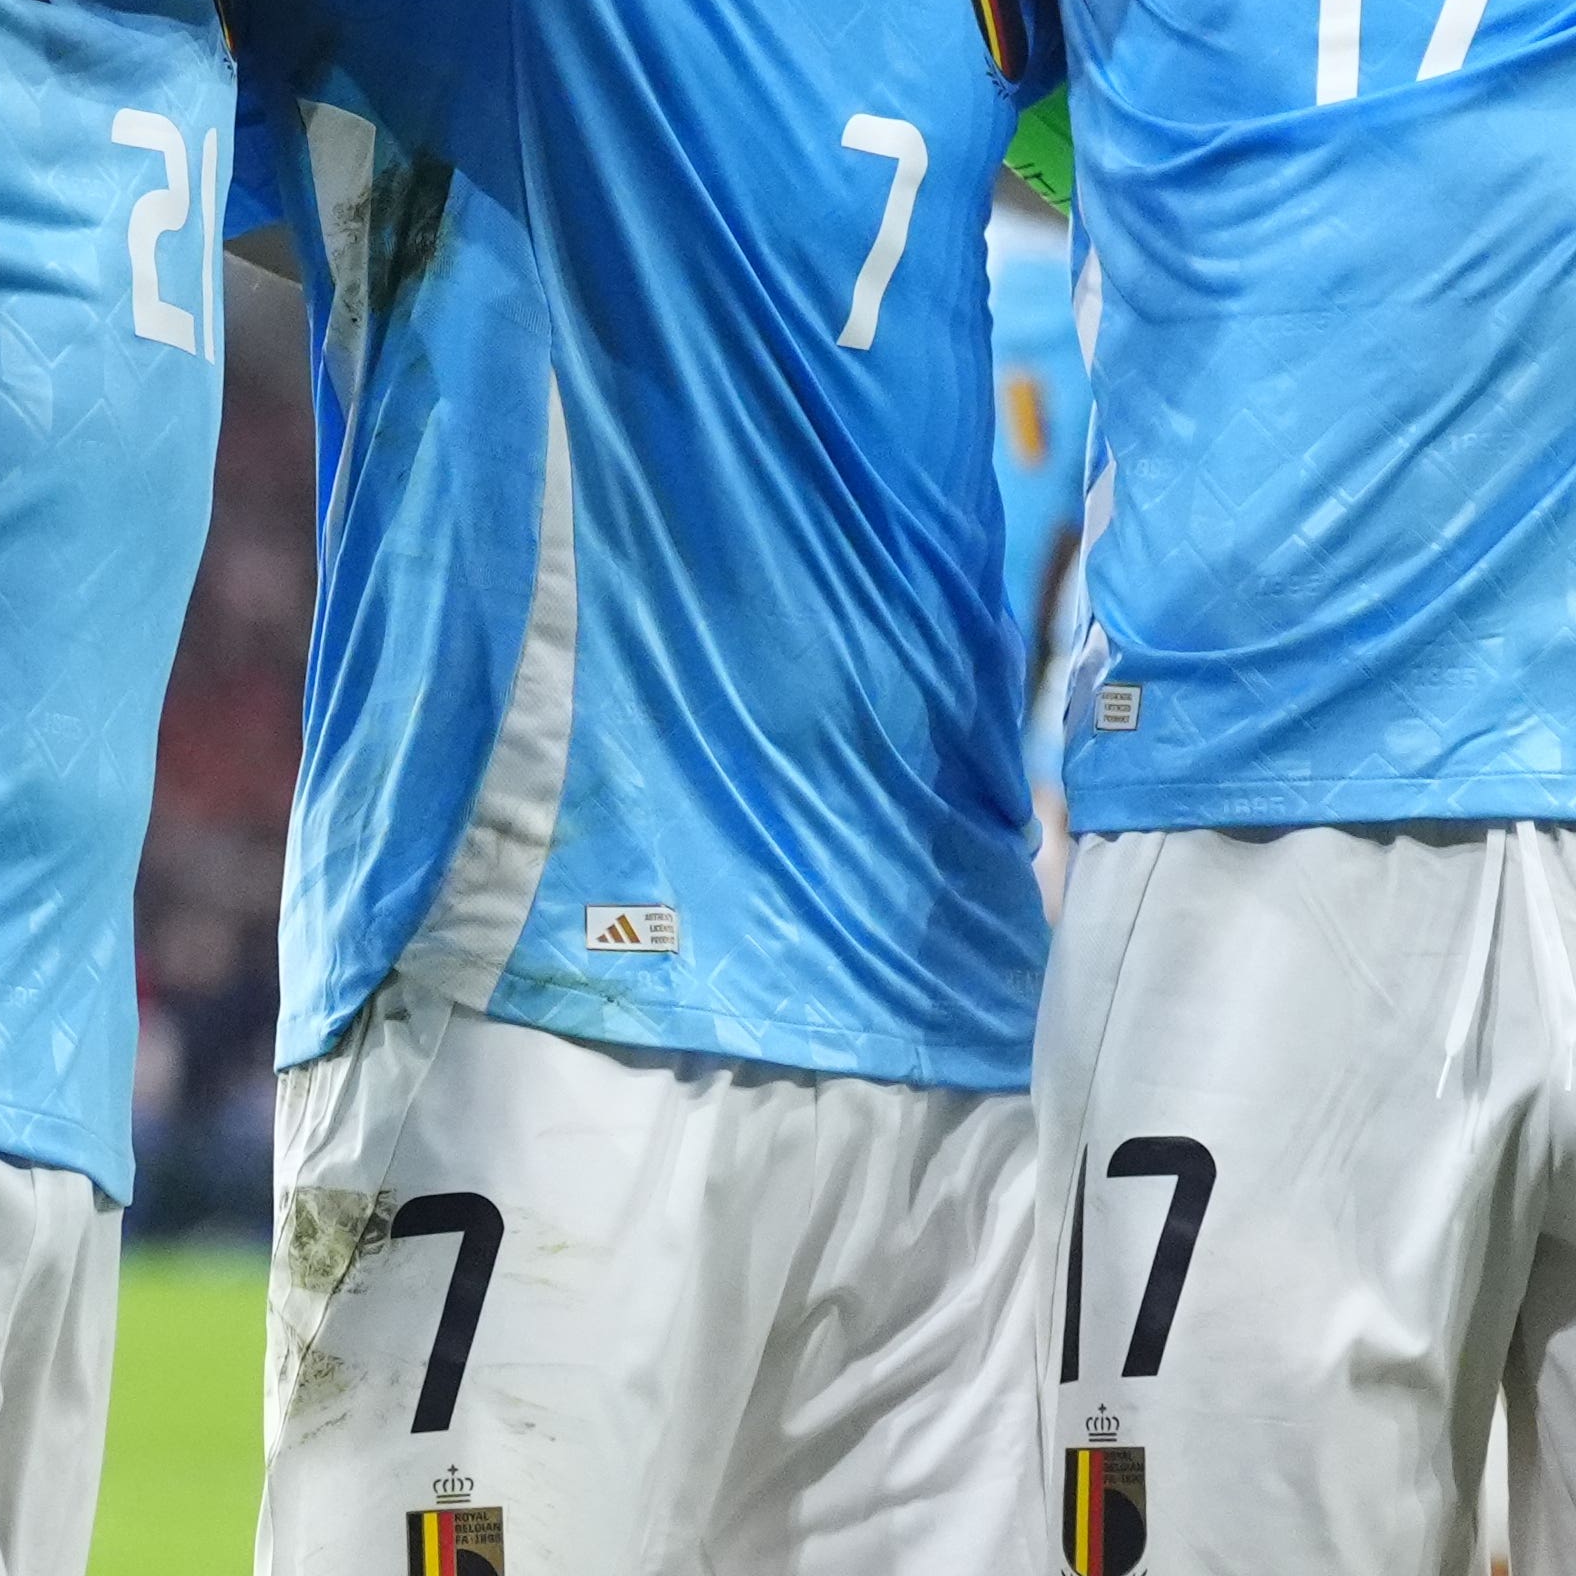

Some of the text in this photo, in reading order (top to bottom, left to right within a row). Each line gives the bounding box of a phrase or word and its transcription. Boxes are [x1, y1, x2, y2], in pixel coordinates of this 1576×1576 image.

[111, 107, 217, 365] 21
[836, 113, 928, 350] 7
[390, 1192, 504, 1434] 7
[1060, 1136, 1217, 1385] 17
[454, 1511, 489, 1523] ROYAL
